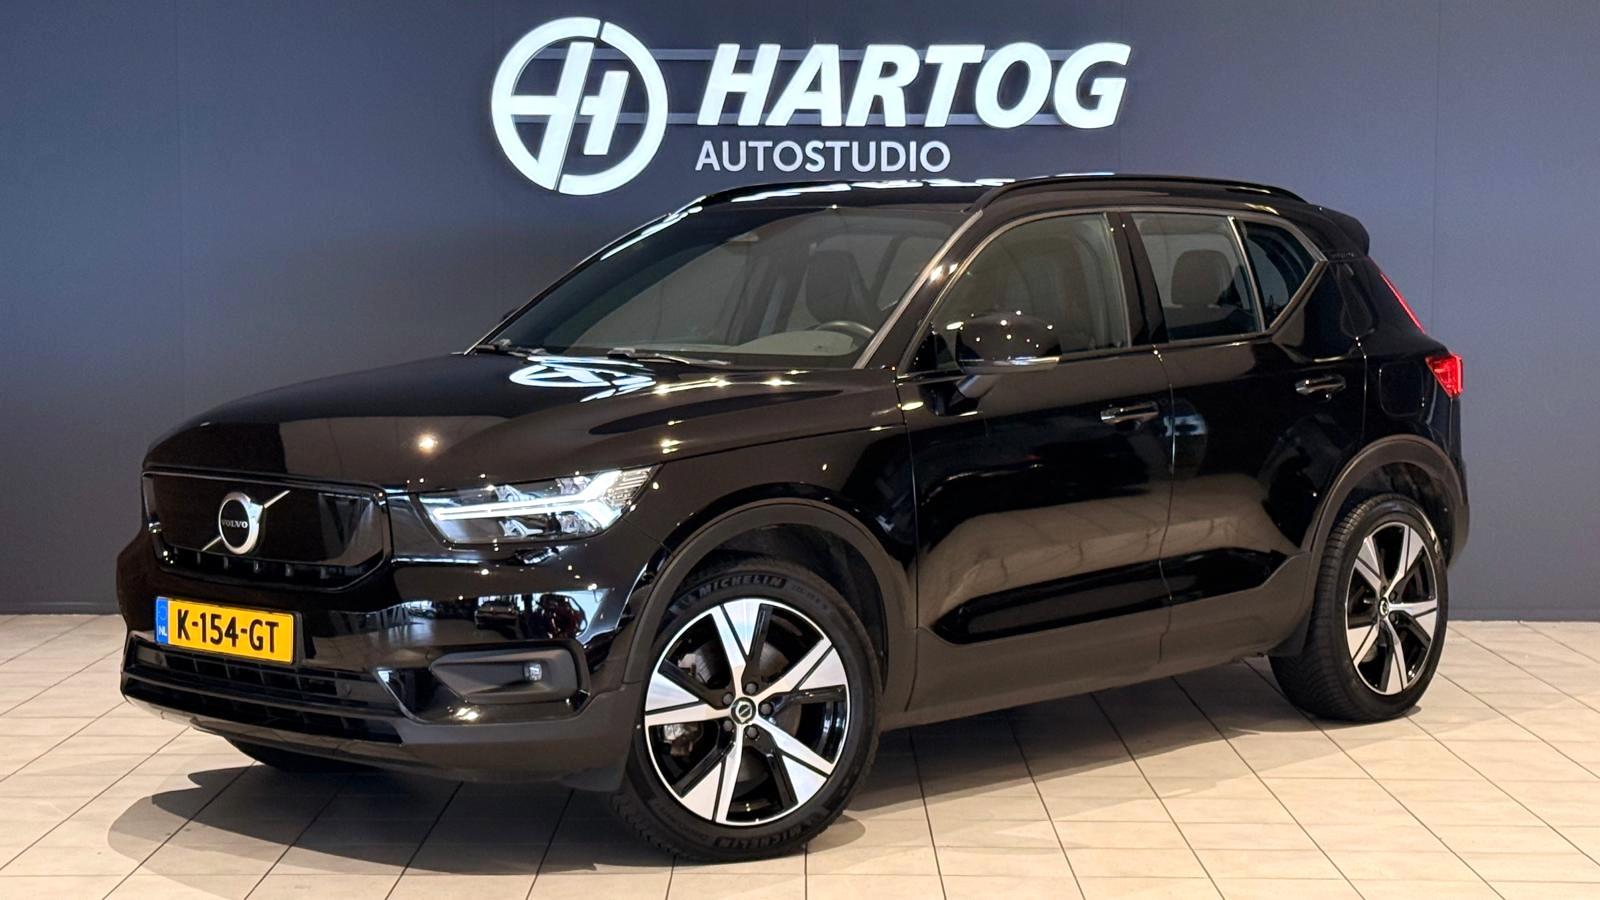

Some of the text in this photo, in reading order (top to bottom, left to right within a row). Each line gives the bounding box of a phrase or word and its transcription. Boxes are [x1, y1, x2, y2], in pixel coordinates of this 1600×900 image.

[697, 43, 1132, 128] HARTOG
[695, 140, 951, 173] AUTOSTUDIO
[221, 519, 249, 529] VOLVO
[698, 575, 782, 595] MICHELIN
[158, 625, 168, 637] NL
[177, 608, 279, 653] K-154-GT
